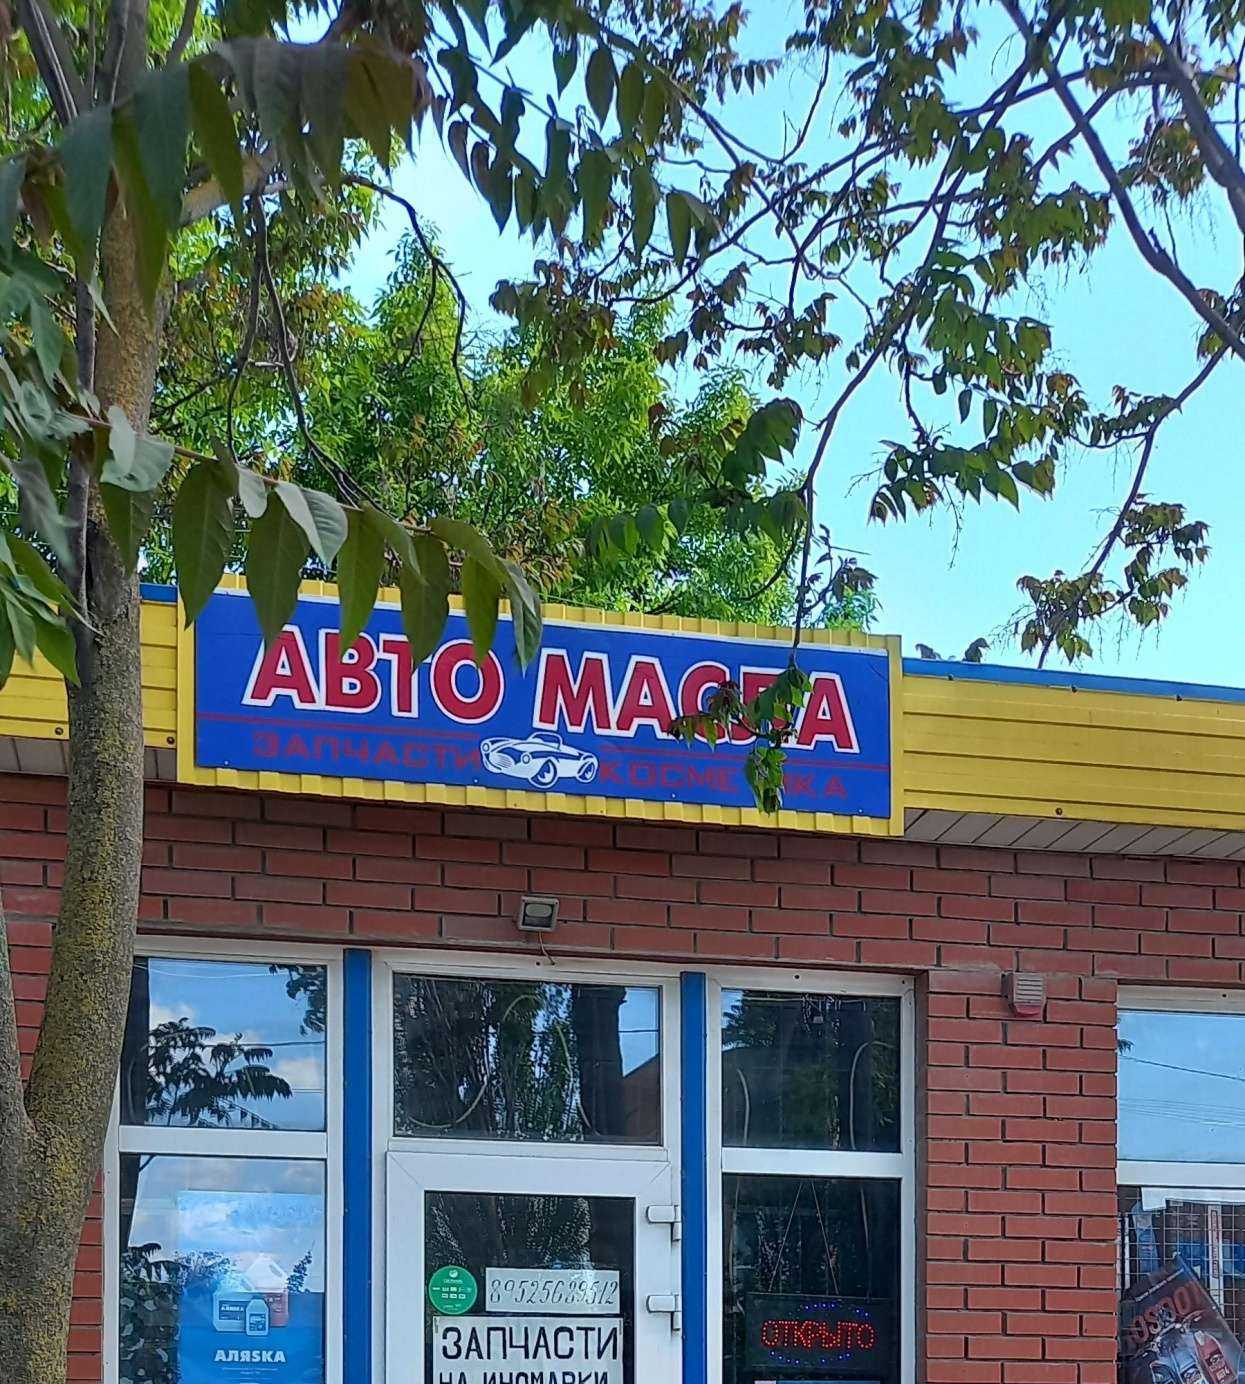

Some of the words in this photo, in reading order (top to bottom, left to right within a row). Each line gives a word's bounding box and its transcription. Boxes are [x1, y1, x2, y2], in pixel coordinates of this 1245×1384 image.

[242, 626, 505, 724] АВТО
[252, 729, 481, 771] ЗАПЧАСТИ
[600, 760, 848, 799] КОСМЕКА
[442, 1326, 618, 1360] ЗАПЧАСТИ
[761, 1319, 876, 1349] ОТКРЫТО
